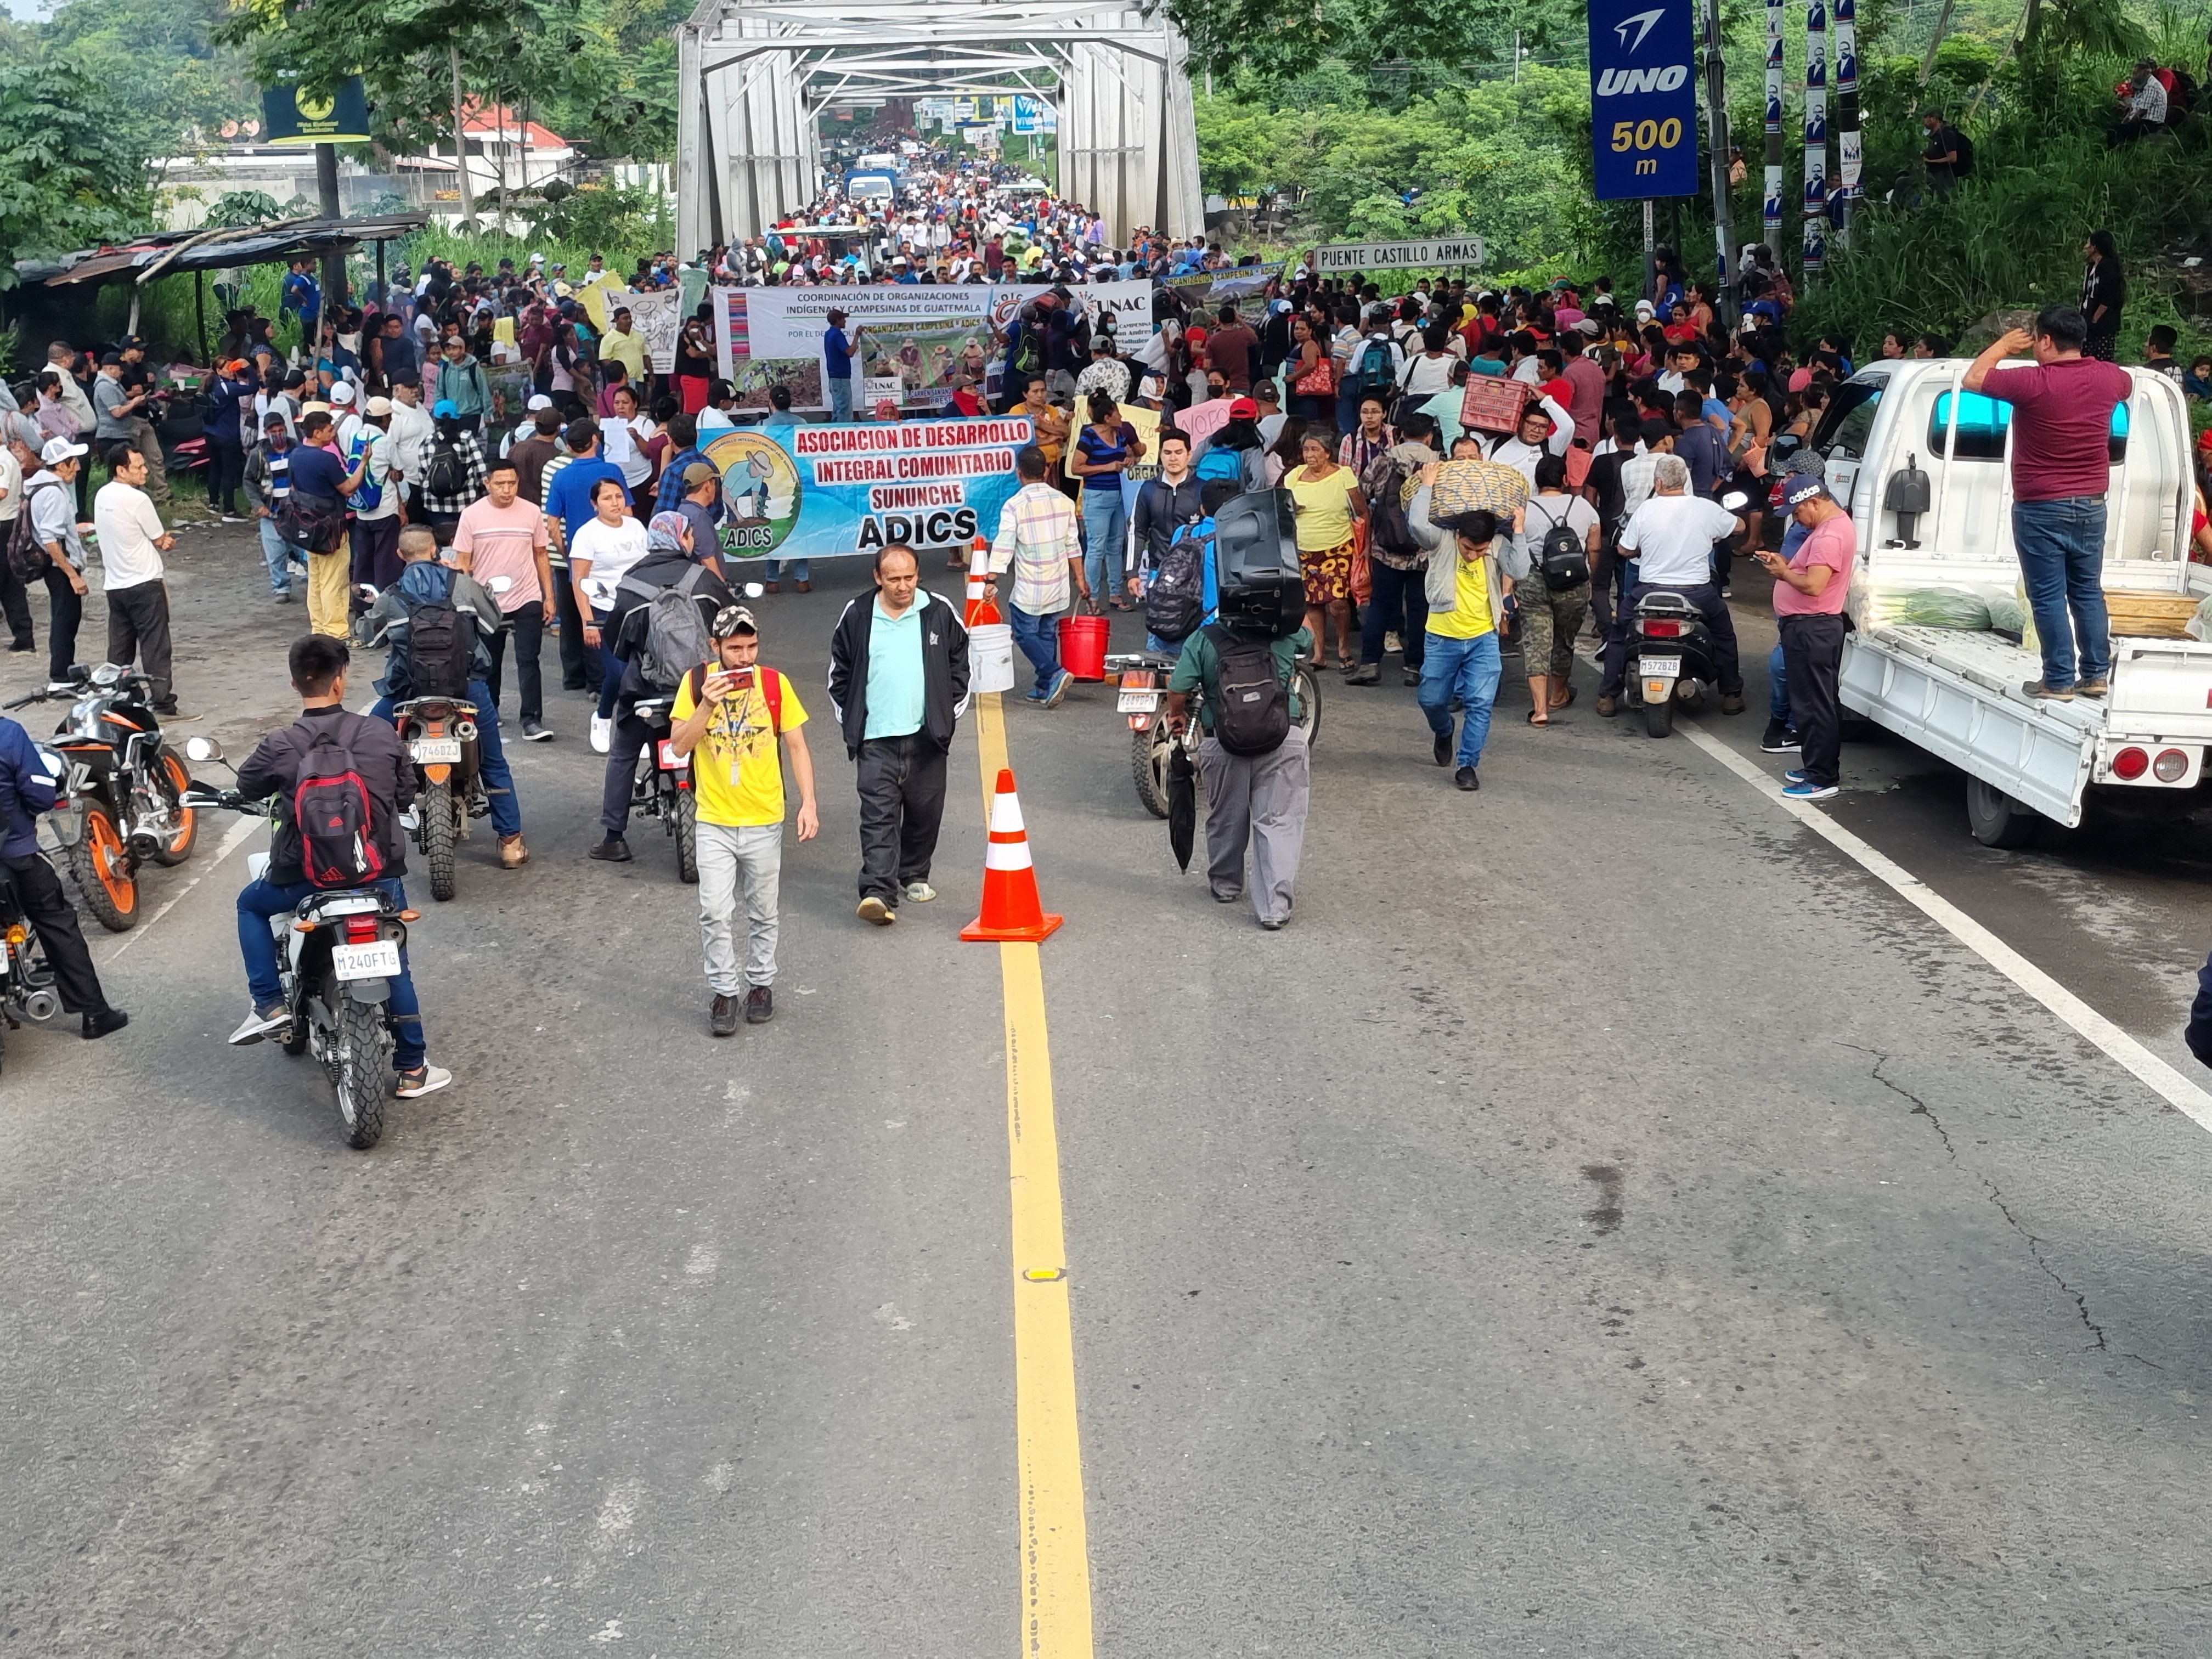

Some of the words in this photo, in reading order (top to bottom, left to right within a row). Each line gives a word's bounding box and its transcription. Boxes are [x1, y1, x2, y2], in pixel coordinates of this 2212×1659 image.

[1596, 65, 1688, 96] UNO
[1611, 117, 1682, 153] 500
[1635, 159, 1657, 175] m
[1322, 250, 1365, 266] PUENTE
[1374, 246, 1427, 264] CASTILLO
[1436, 244, 1477, 261] ARMAS
[1216, 269, 1254, 281] CAMPESINA
[797, 291, 870, 302] COORDINACIÓN
[873, 292, 884, 301] DE
[887, 292, 969, 301] ORGANIZACIONES
[1097, 296, 1146, 313] UNAC
[839, 305, 845, 313] Y
[848, 304, 907, 313] CAMPESINAS
[910, 304, 922, 313] DE
[924, 304, 981, 313] GUATEMALA
[874, 381, 896, 390] UNAC
[911, 389, 930, 398] CARMEN
[931, 388, 941, 397] SAN
[797, 430, 898, 453] ASOCIACION
[901, 427, 921, 448] DE
[926, 422, 1029, 447] DESARROLLO
[759, 441, 784, 461] COMUNITARIO
[817, 459, 895, 483] INTEGRAL
[898, 450, 1012, 478] COMUNITARIO
[872, 484, 962, 509] SUNUNCHE
[1789, 484, 1820, 504] adidas
[725, 527, 771, 548] ADICS
[857, 509, 975, 549] ADICS
[1641, 661, 1678, 672] M572BZB
[337, 951, 396, 970] M240FTG
